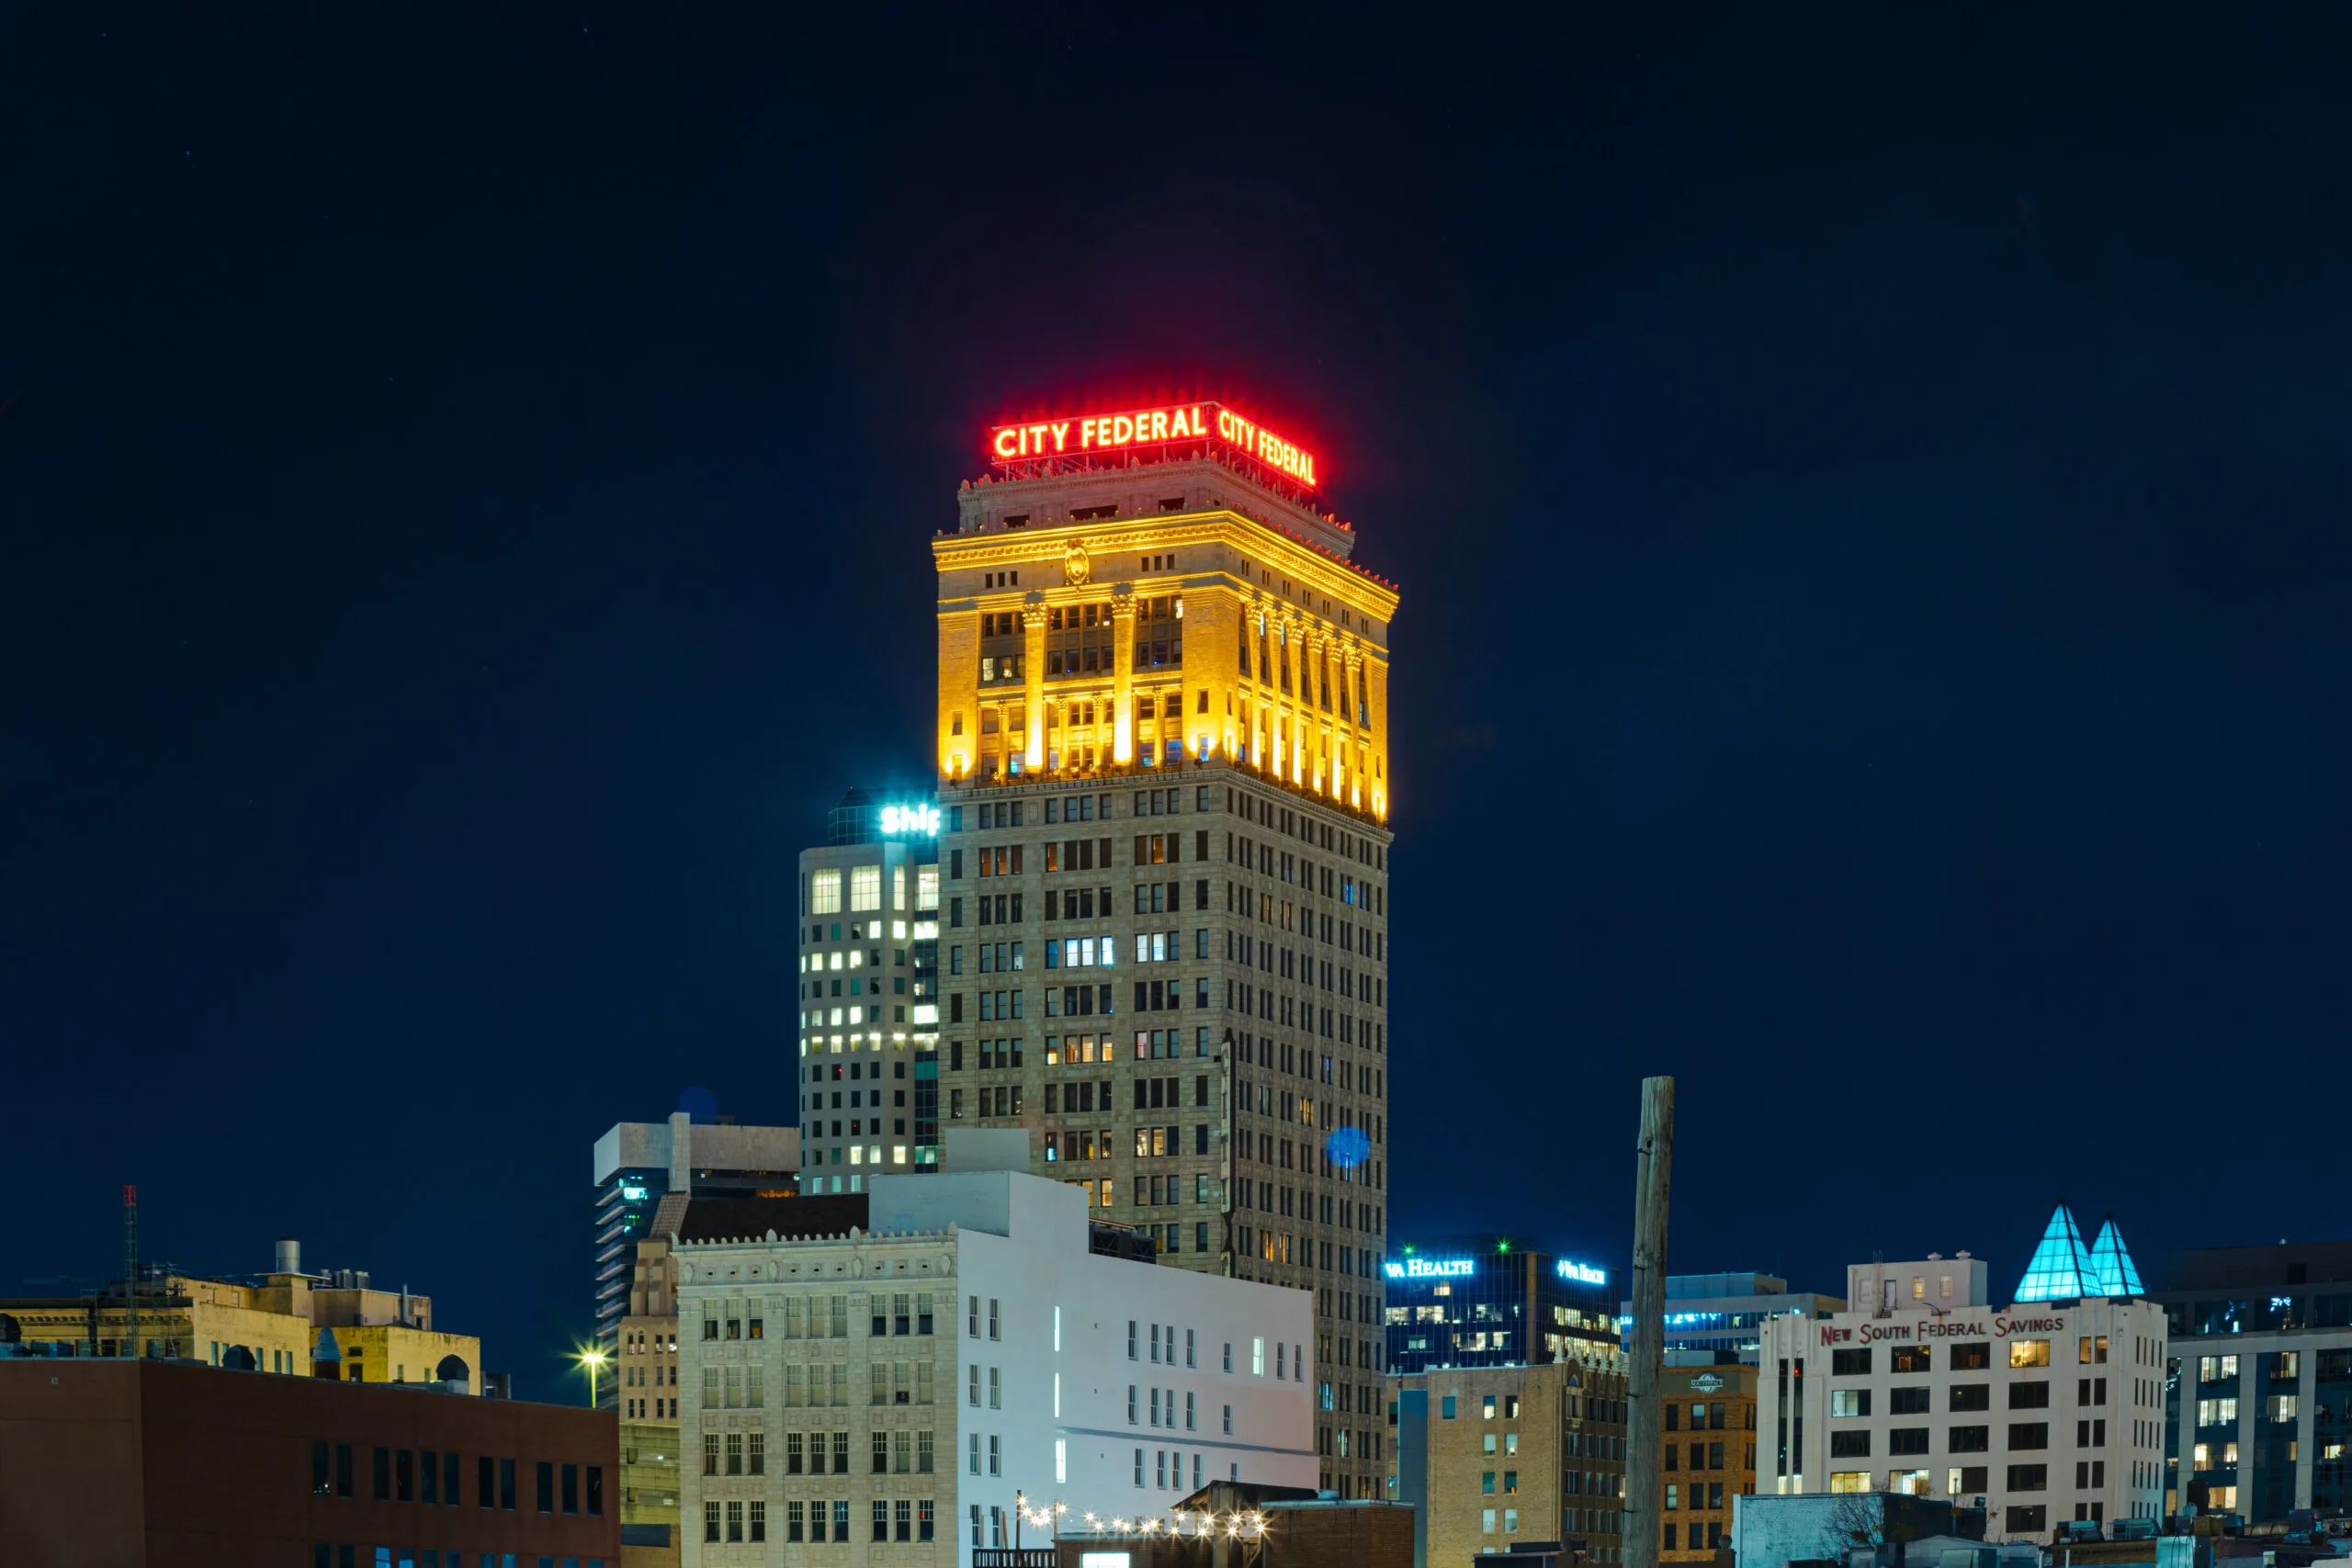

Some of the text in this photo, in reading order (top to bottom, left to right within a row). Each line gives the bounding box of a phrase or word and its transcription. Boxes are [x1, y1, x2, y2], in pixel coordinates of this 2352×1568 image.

[995, 407, 1206, 457] CITY FEDERAL
[1218, 410, 1316, 485] CITY FEDERAL
[1408, 1259, 1473, 1276] HEALTH
[1821, 1317, 2064, 1347] NEW SOUTH FEDERAL SAVINGS
